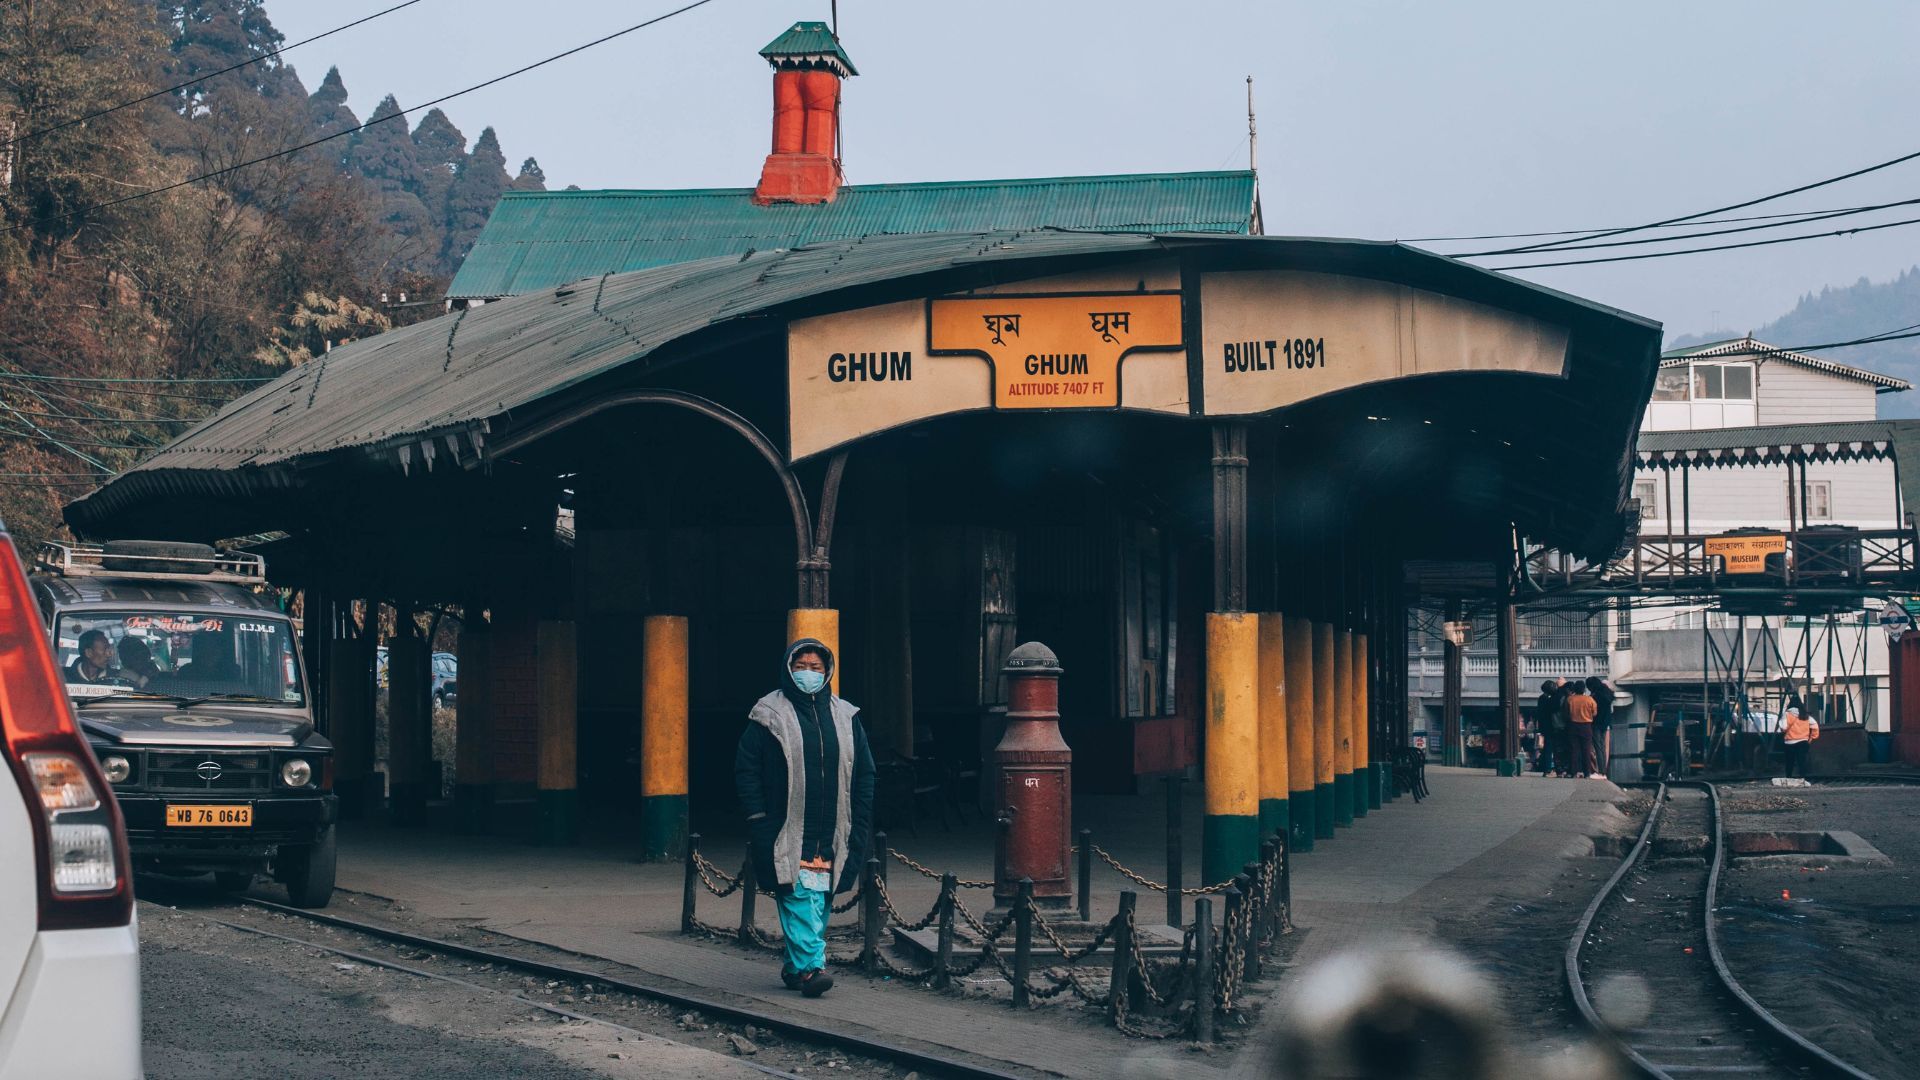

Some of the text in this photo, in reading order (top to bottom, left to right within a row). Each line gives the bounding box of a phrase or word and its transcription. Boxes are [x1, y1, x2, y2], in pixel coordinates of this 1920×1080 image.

[982, 314, 1022, 347] ঘুম
[1088, 312, 1131, 345] घूम
[827, 351, 912, 383] GHUM
[1024, 353, 1089, 376] GHUM
[1223, 337, 1325, 373] BUILT 1891
[1008, 381, 1105, 396] ALTITUDE 7407 FT
[1731, 555, 1760, 564] MUSEUM
[177, 810, 248, 823] WB 76 0643
